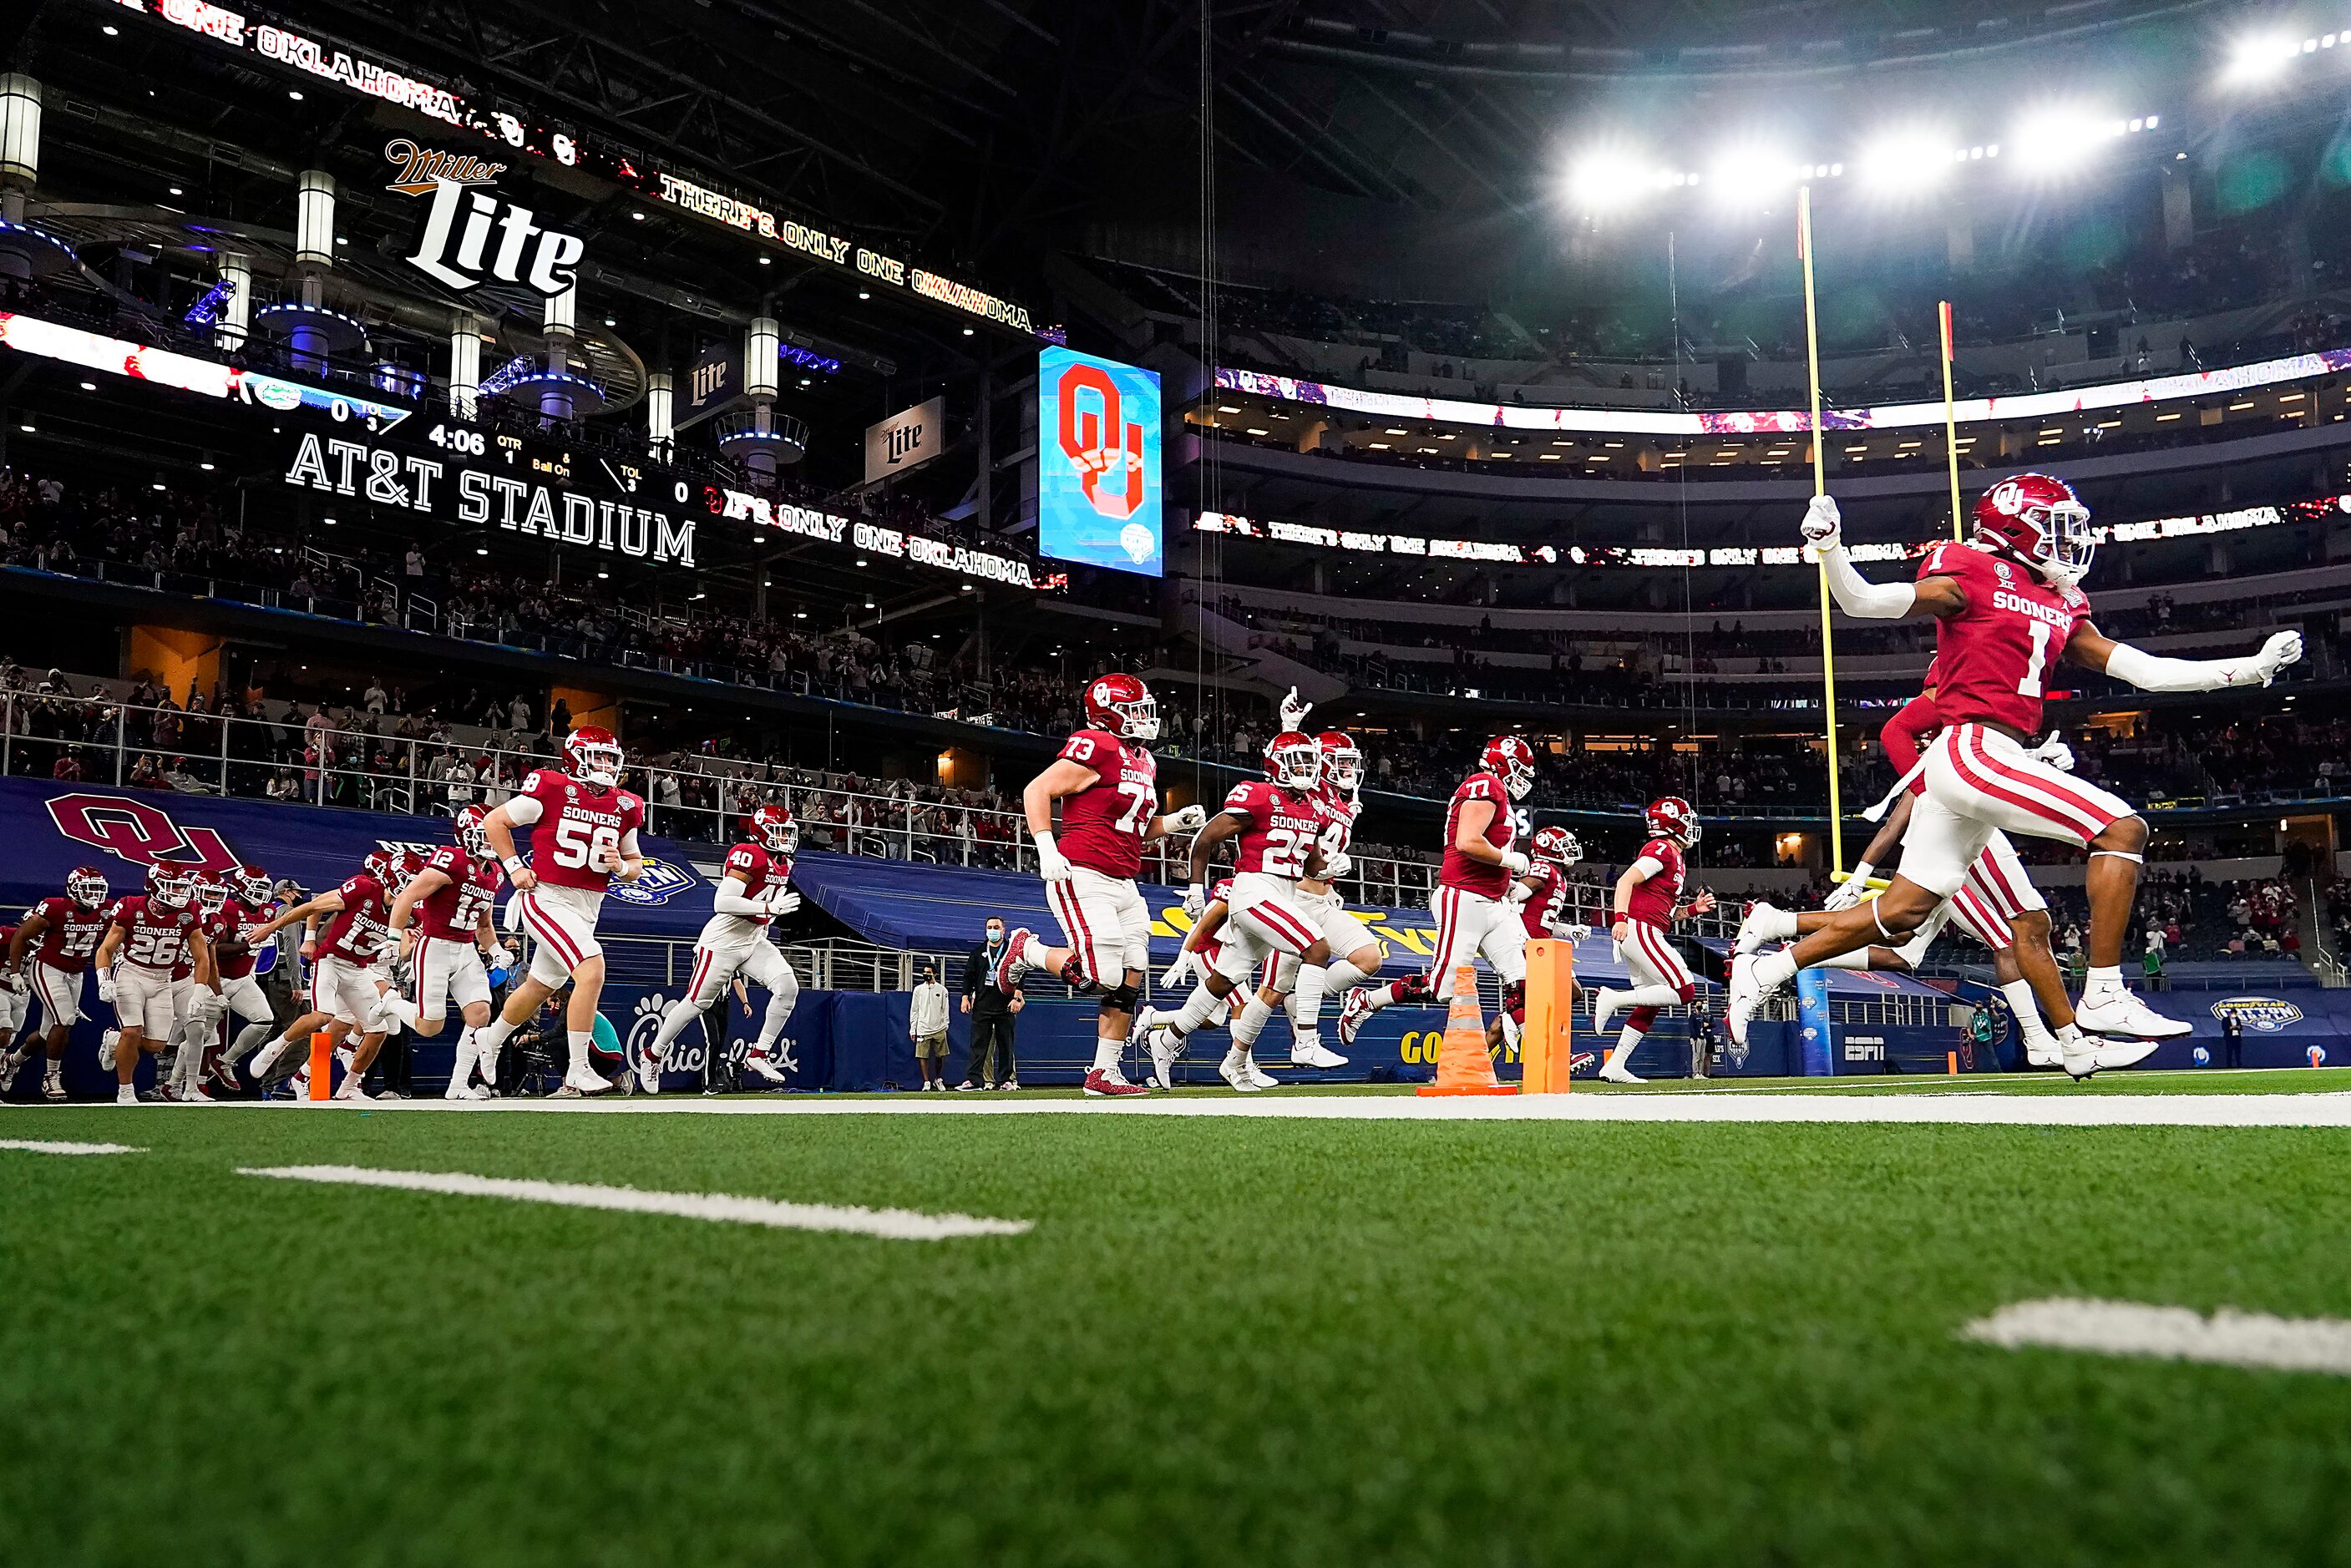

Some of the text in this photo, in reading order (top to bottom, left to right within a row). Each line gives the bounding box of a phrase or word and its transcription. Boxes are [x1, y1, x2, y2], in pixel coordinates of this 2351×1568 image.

[257, 25, 459, 125] OKLAHOMA
[385, 139, 506, 184] Miller
[405, 174, 584, 294] Lite
[660, 173, 776, 238] THERE'S
[783, 221, 851, 264] ONLY
[857, 248, 904, 286] ONE
[691, 362, 727, 406] Lite
[331, 399, 349, 422] 0
[367, 417, 377, 432] 3
[428, 424, 485, 456] 4:06
[497, 435, 522, 451] QTR
[884, 423, 923, 464] Lite
[1058, 362, 1143, 520] OU
[504, 451, 514, 464] 1
[533, 458, 570, 478] Ball On
[562, 453, 570, 463] &
[621, 464, 642, 480] TOL
[627, 478, 636, 492] 3
[286, 432, 697, 569] AT&T STADIUM
[675, 482, 689, 503] 0
[1992, 482, 2024, 515] OU
[779, 503, 848, 542] ONLY
[853, 523, 903, 557] ONE
[909, 539, 1032, 586] OKLAHOMA
[1268, 521, 1337, 546] THERE'S
[1340, 531, 1386, 551] ONLY
[1391, 535, 1425, 554] ONE
[1710, 548, 1757, 565] ONLY
[1928, 545, 1946, 571] 1
[1993, 590, 2074, 634] SOONERS
[2017, 619, 2051, 698] 1
[1093, 682, 1111, 708] OU
[1065, 736, 1096, 761] 73
[1226, 784, 1254, 802] 25
[1466, 779, 1490, 799] 77
[563, 806, 622, 828] SOONERS
[1114, 781, 1158, 837] 73
[44, 793, 243, 875] OU
[1269, 815, 1320, 833] SOONERS
[553, 817, 619, 873] 58
[1262, 828, 1317, 878] 25
[1655, 842, 1667, 856] 7
[430, 849, 454, 869] 12
[729, 850, 753, 868] 40
[1530, 862, 1551, 878] 22
[342, 878, 357, 893] 13
[1214, 883, 1231, 900] 36
[449, 894, 492, 931] 12
[133, 925, 182, 937] SOONERS
[337, 920, 388, 956] 13
[60, 931, 98, 958] 14
[127, 933, 180, 966] 26
[1845, 1036, 1885, 1061] ESPN
